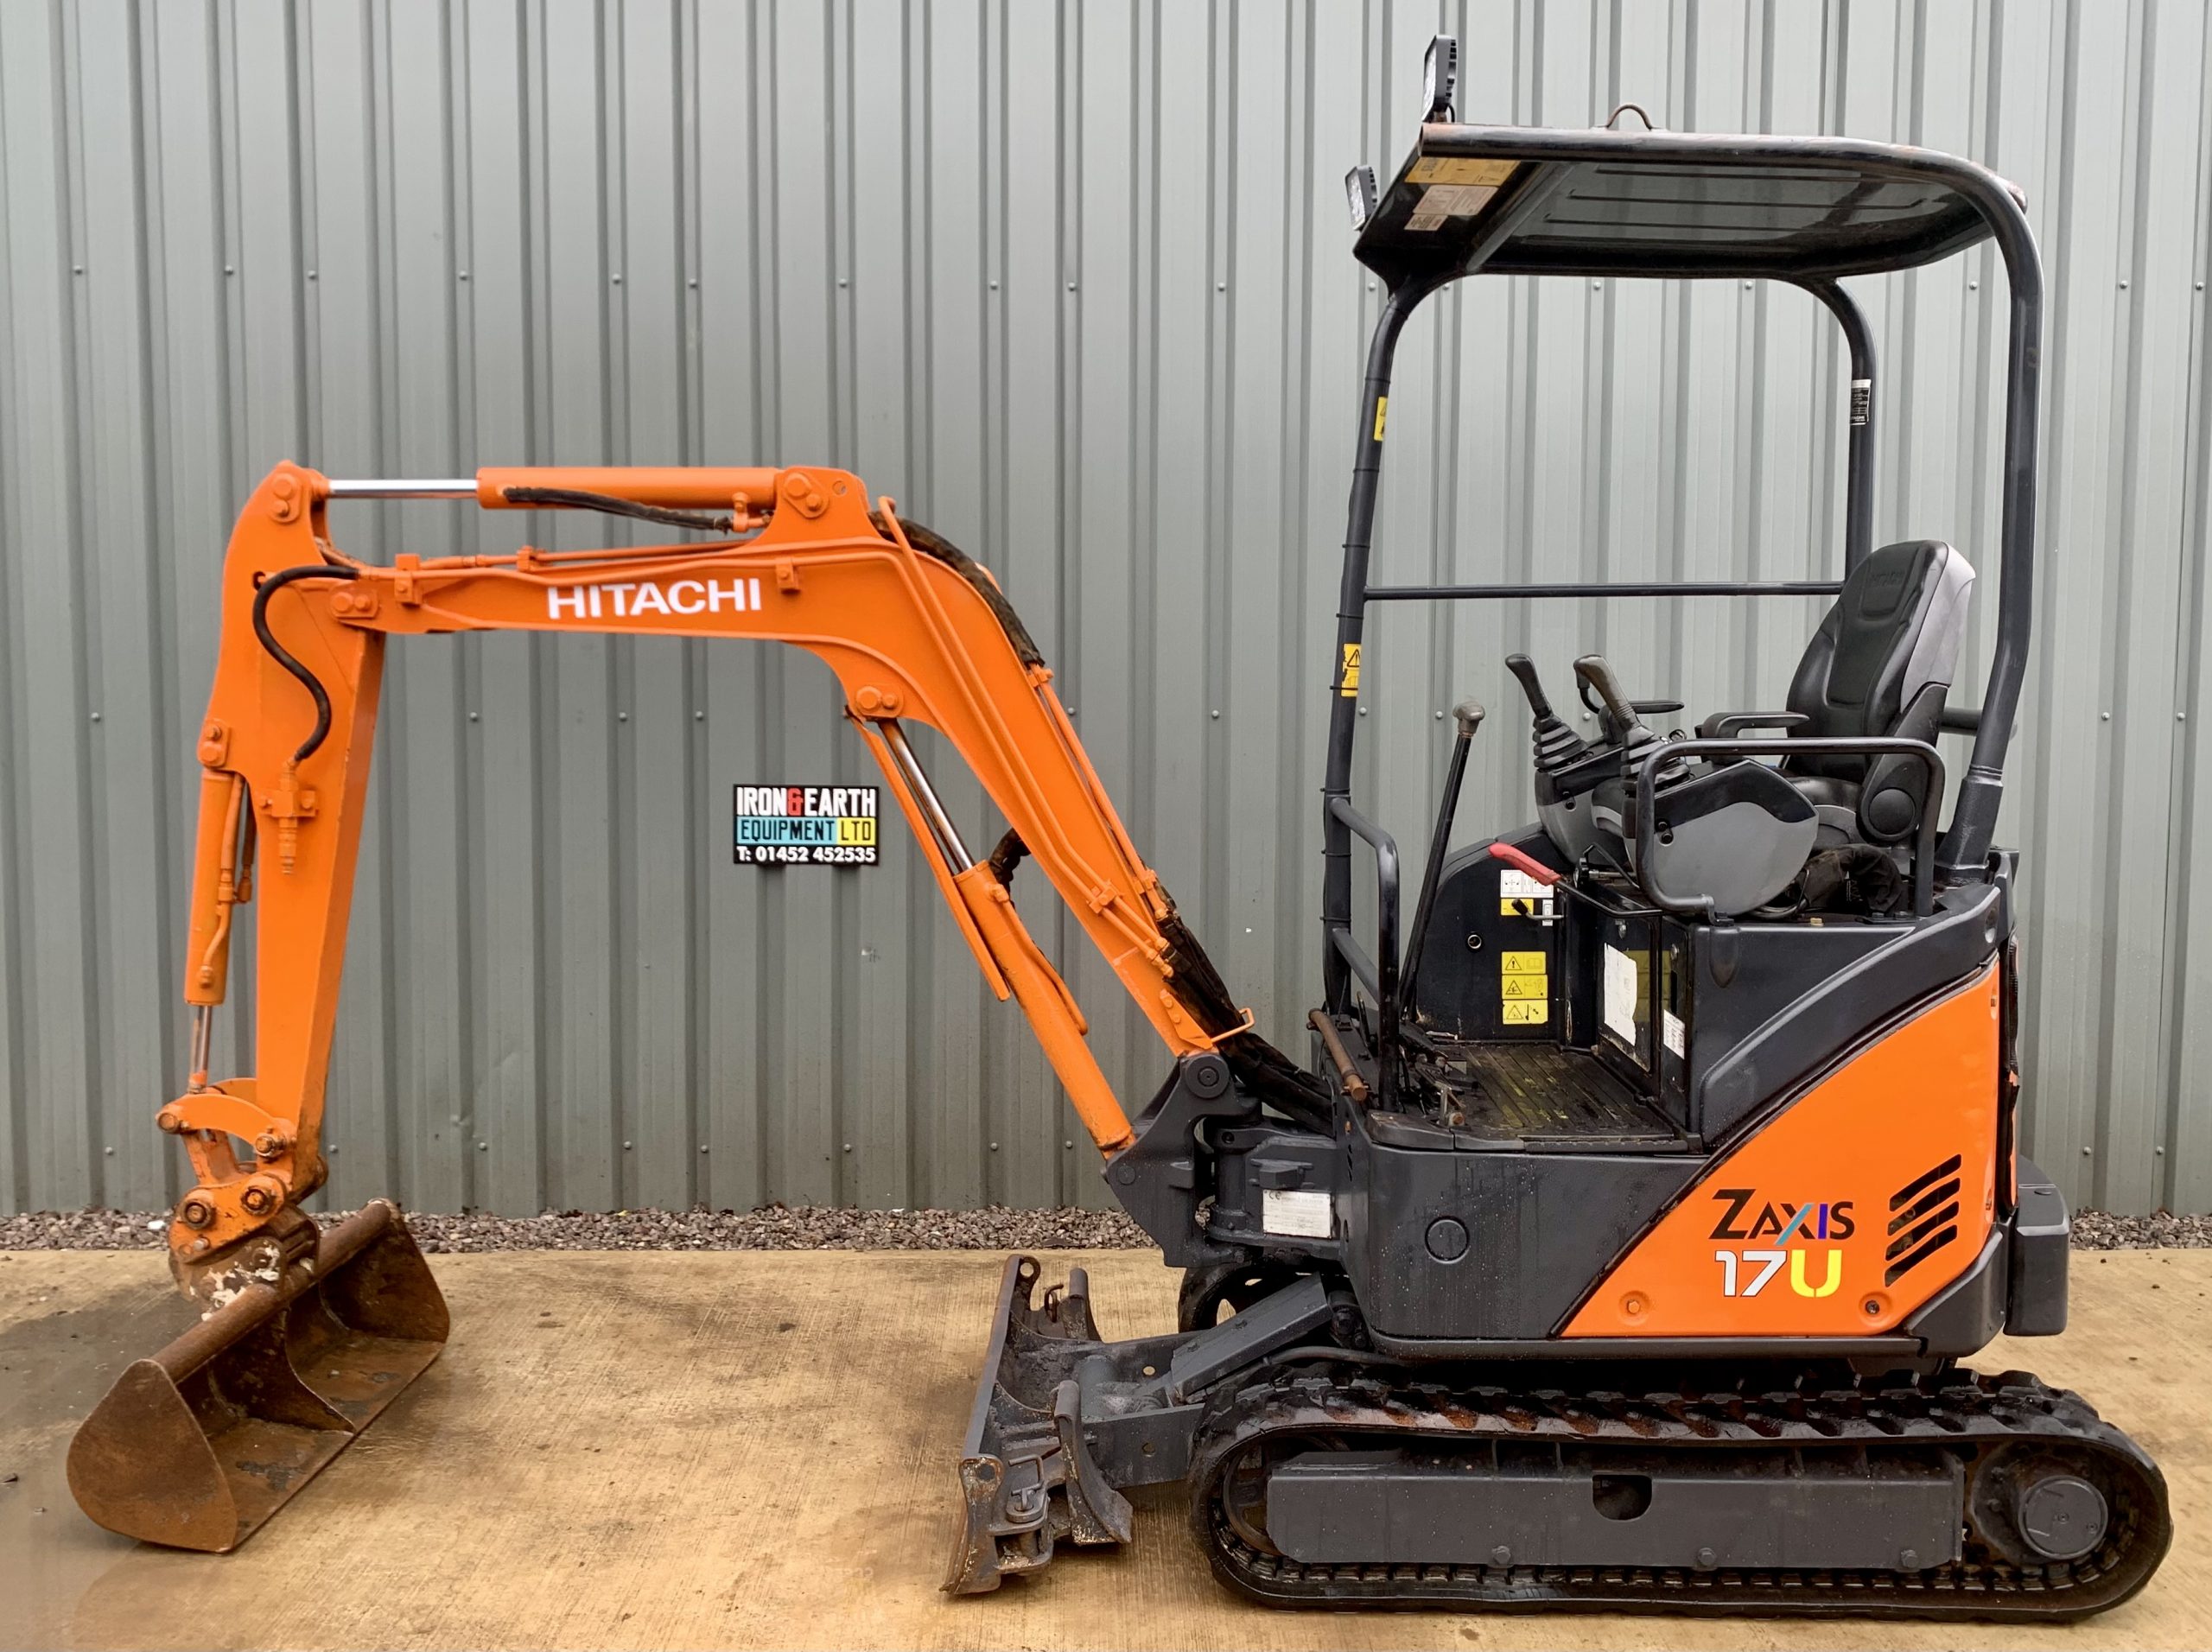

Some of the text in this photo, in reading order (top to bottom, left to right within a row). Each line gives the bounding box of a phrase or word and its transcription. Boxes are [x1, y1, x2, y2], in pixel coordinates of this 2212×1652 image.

[547, 578, 761, 620] HITACHI
[741, 819, 871, 842] EQUIPMENT LTD
[736, 846, 876, 861] T: 01452 452535
[1708, 1189, 1855, 1246] ZAXIS
[1715, 1249, 1842, 1298] 17U
